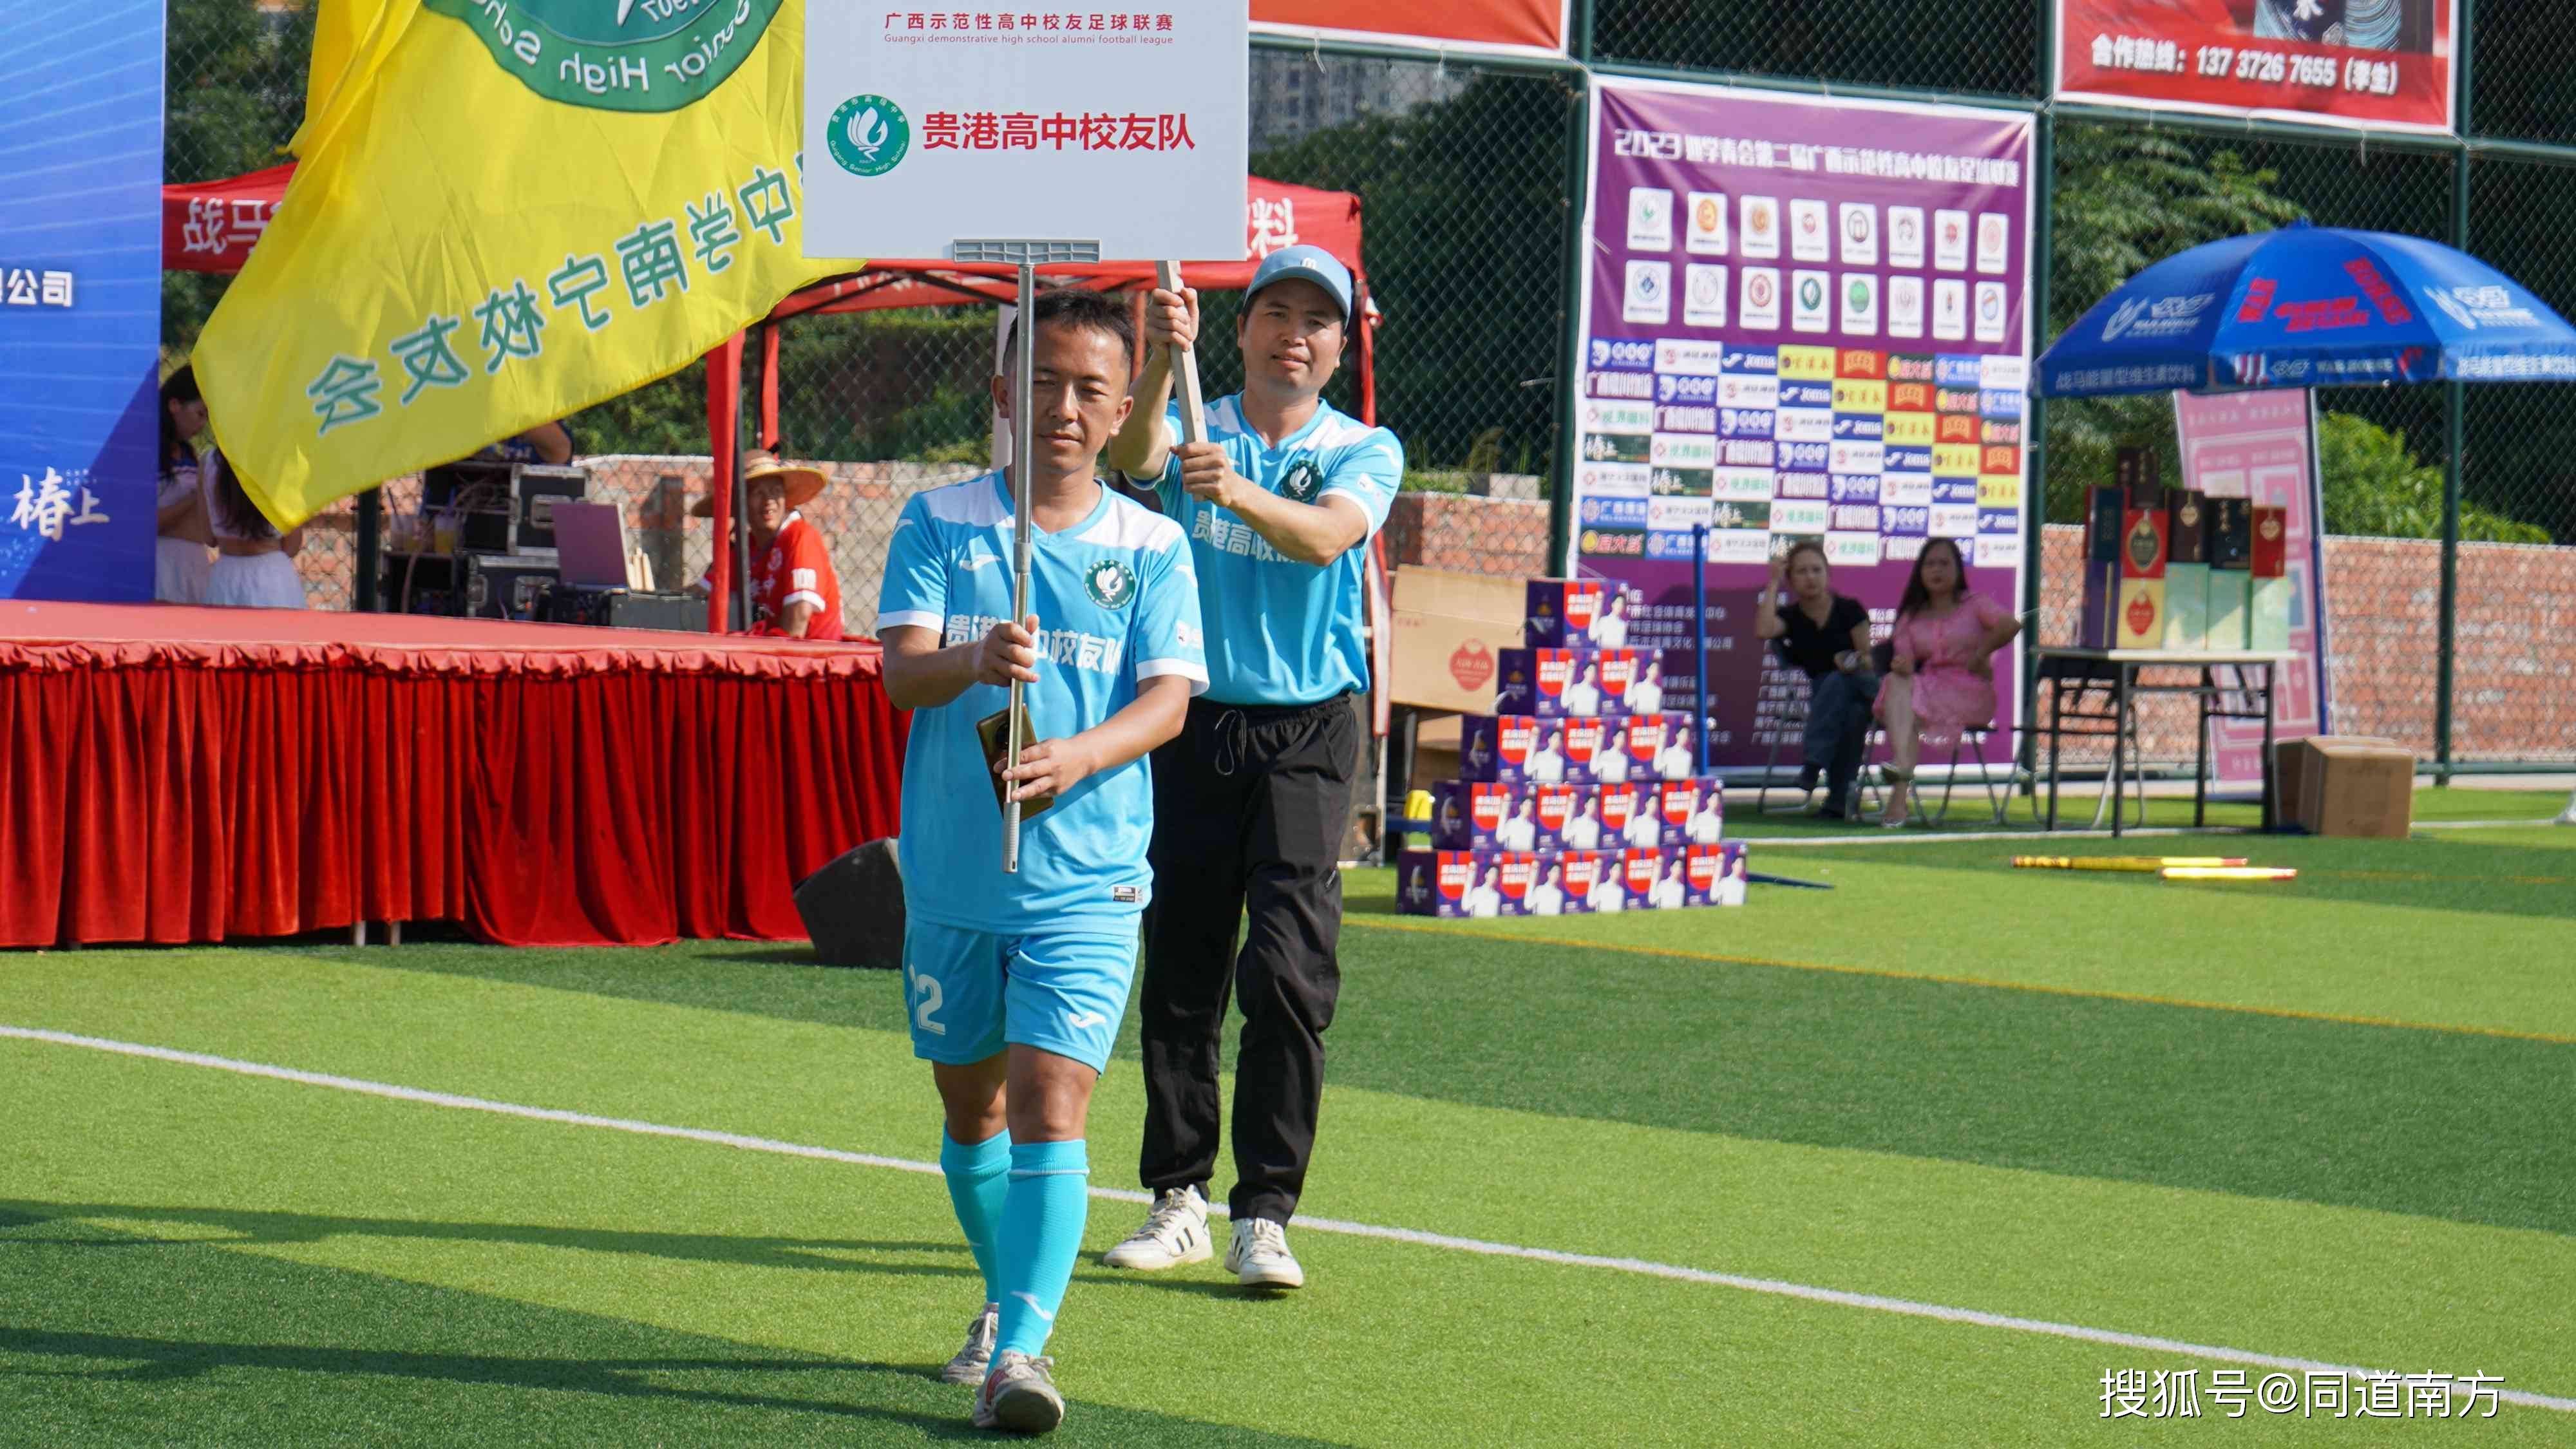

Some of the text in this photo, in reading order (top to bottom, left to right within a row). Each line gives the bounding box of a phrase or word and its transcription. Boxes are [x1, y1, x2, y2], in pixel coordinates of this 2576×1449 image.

[884, 33, 1173, 46] Guangxi demonstrative high school alumni football league
[885, 12, 1173, 31] 广西示范性高中校友足球联赛
[2197, 45, 2233, 77] 137
[2235, 49, 2286, 82] 3726
[2289, 54, 2337, 87] 7655
[922, 111, 1196, 151] 贵港高中校友队
[1615, 129, 1683, 160] 2023
[0, 268, 73, 307] 公司
[946, 613, 1124, 676] 贵港中校友队
